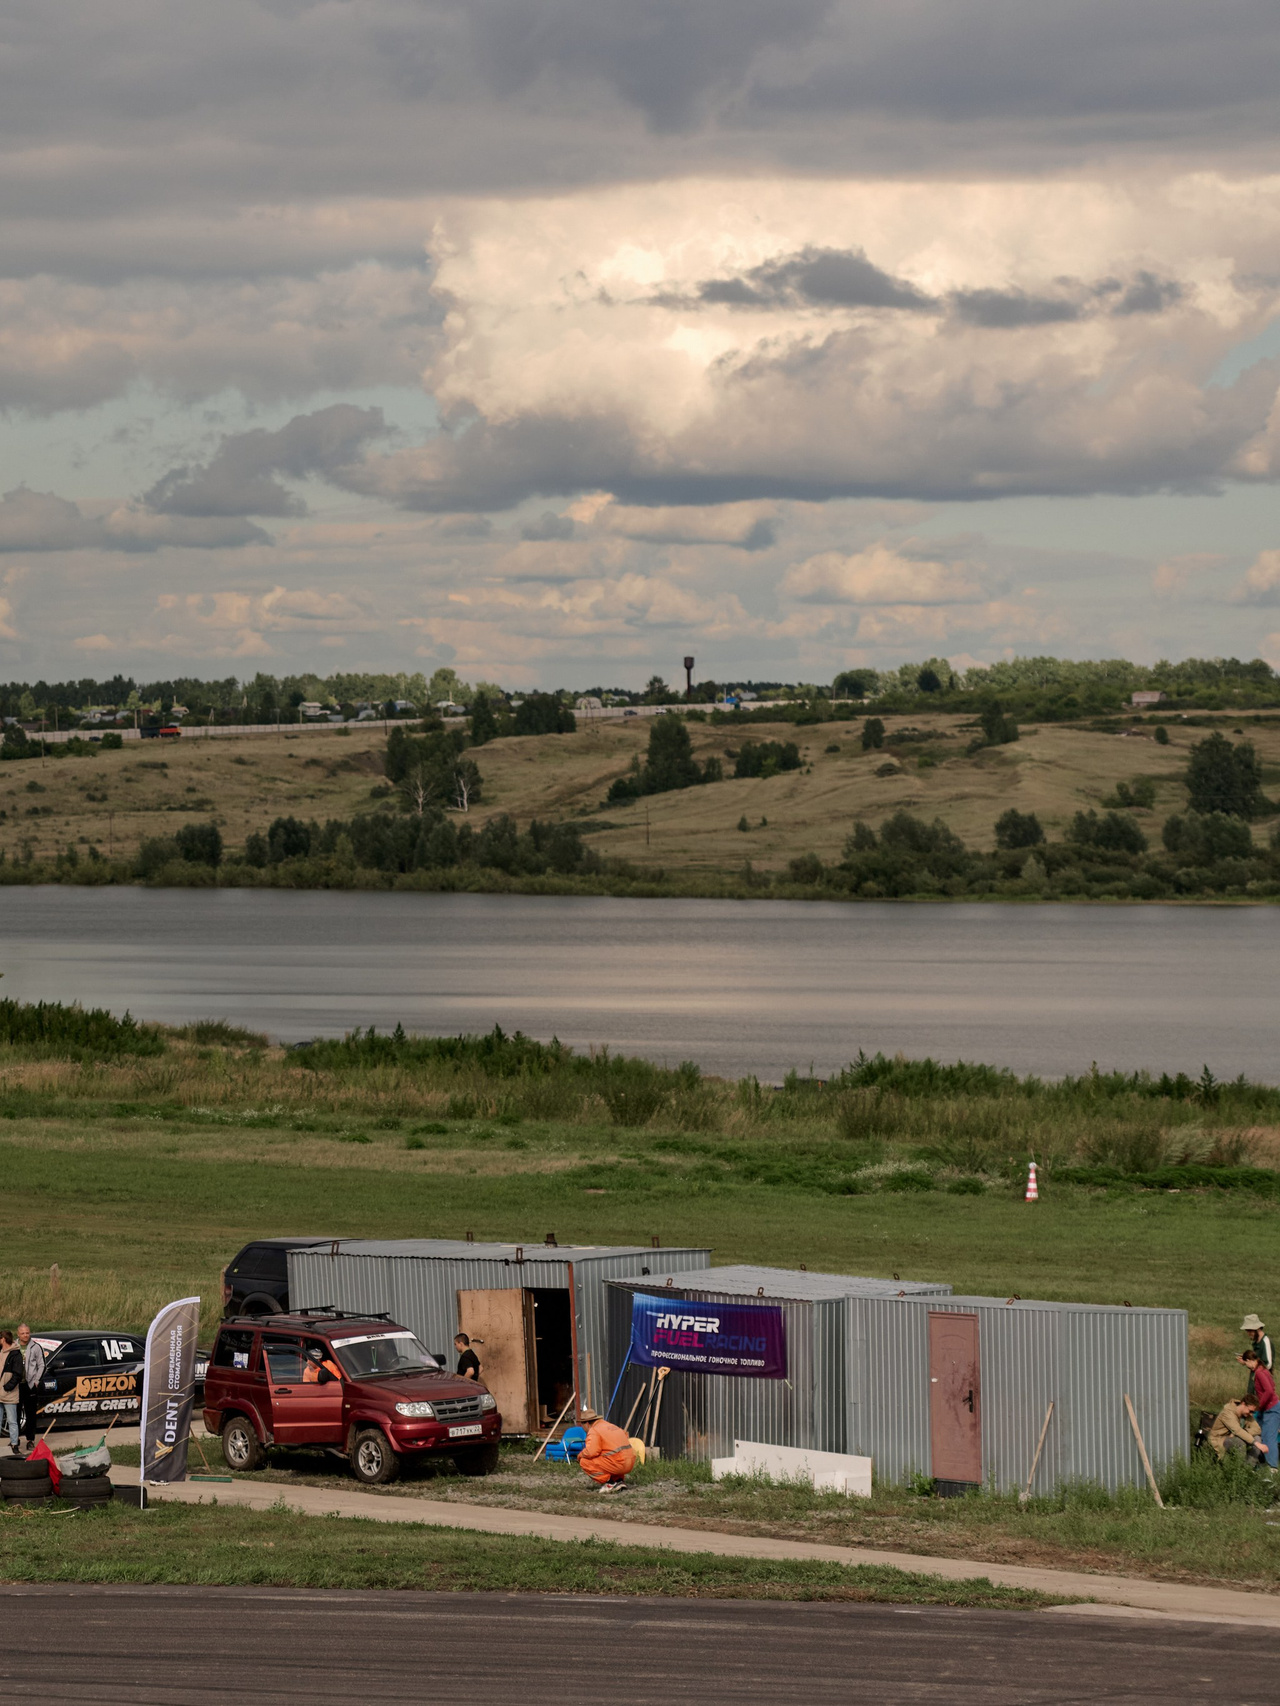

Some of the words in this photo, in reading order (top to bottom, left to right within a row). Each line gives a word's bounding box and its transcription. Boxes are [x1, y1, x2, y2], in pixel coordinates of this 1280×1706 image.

[655, 1312, 720, 1334] HYPER
[101, 1340, 123, 1360] 14
[168, 1330, 176, 1390] СОВРЕМЕННАЯ
[174, 1325, 182, 1390] СТОМАТОЛОГИЯ
[650, 1350, 707, 1363] ПРОФЕССИОНАЛЬНОЕ
[708, 1356, 738, 1365] ГОНОЧНОЕ
[740, 1358, 765, 1367] ТОПЛИВО
[90, 1376, 137, 1392] BIZON
[44, 1401, 98, 1413] CHASER
[100, 1399, 139, 1410] CREW
[164, 1400, 179, 1443] DENT
